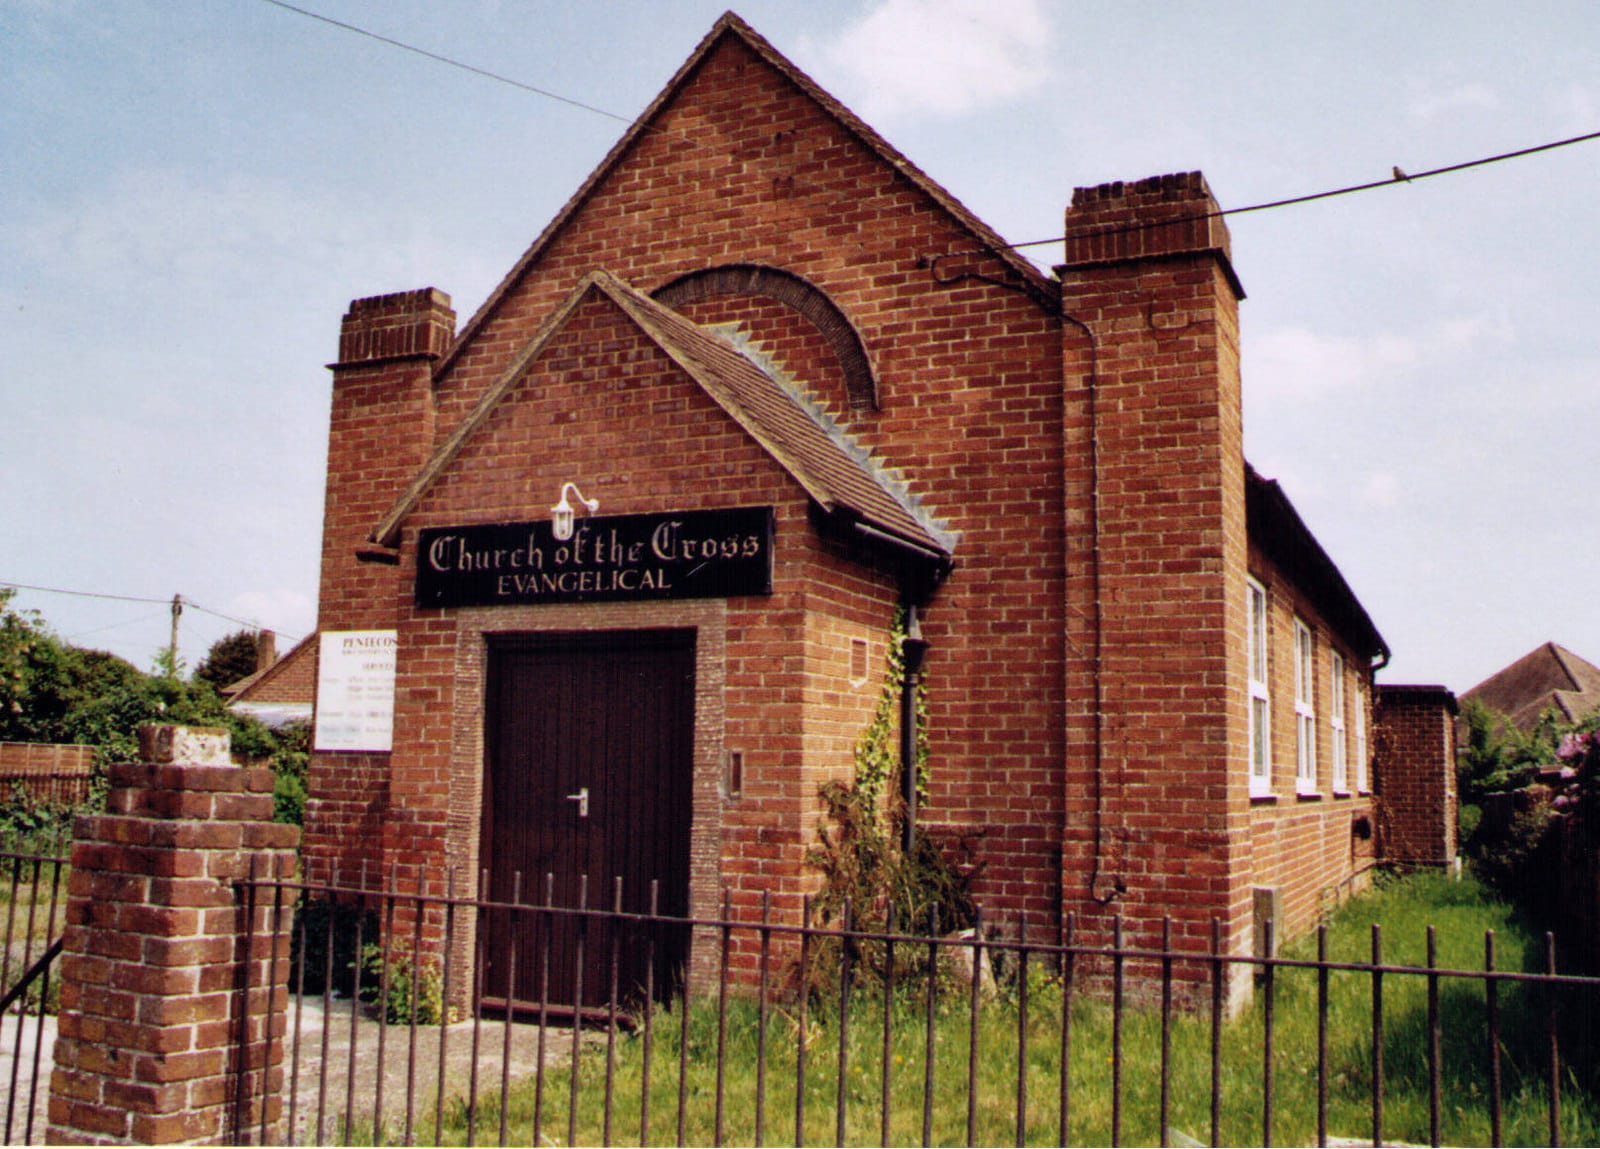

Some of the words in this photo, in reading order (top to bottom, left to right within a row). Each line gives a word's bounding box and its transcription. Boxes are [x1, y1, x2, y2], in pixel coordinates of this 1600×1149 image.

[428, 534, 543, 572] Church
[553, 526, 592, 565] of
[595, 529, 646, 564] the
[651, 521, 759, 561] Cross
[497, 569, 672, 595] EVANGELICAL
